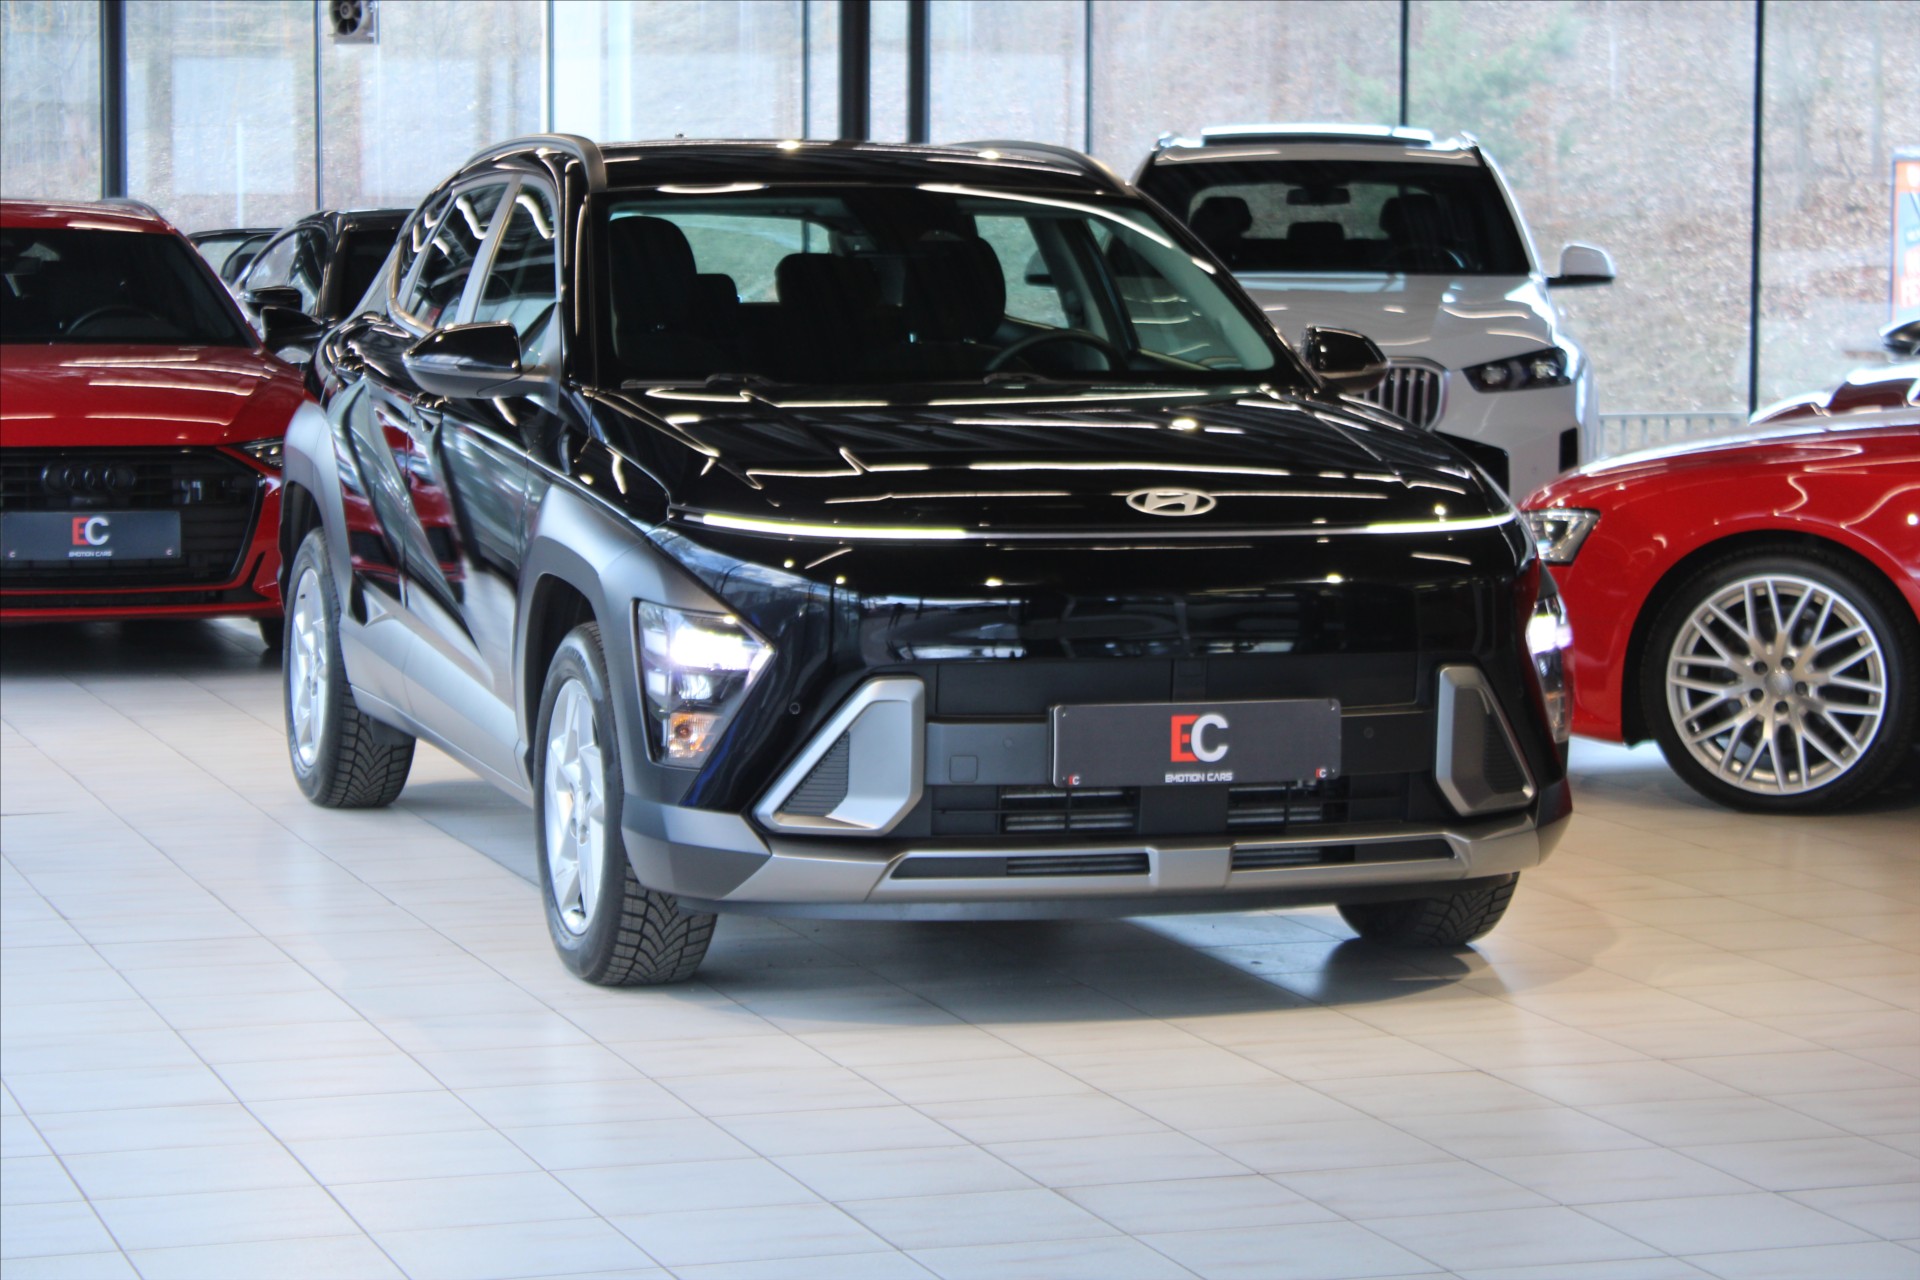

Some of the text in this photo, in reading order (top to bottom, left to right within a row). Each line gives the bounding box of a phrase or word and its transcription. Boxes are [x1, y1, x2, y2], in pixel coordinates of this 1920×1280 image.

[72, 516, 109, 546] EC
[1171, 713, 1228, 762] EC
[1165, 771, 1233, 783] EMOTION CARS
